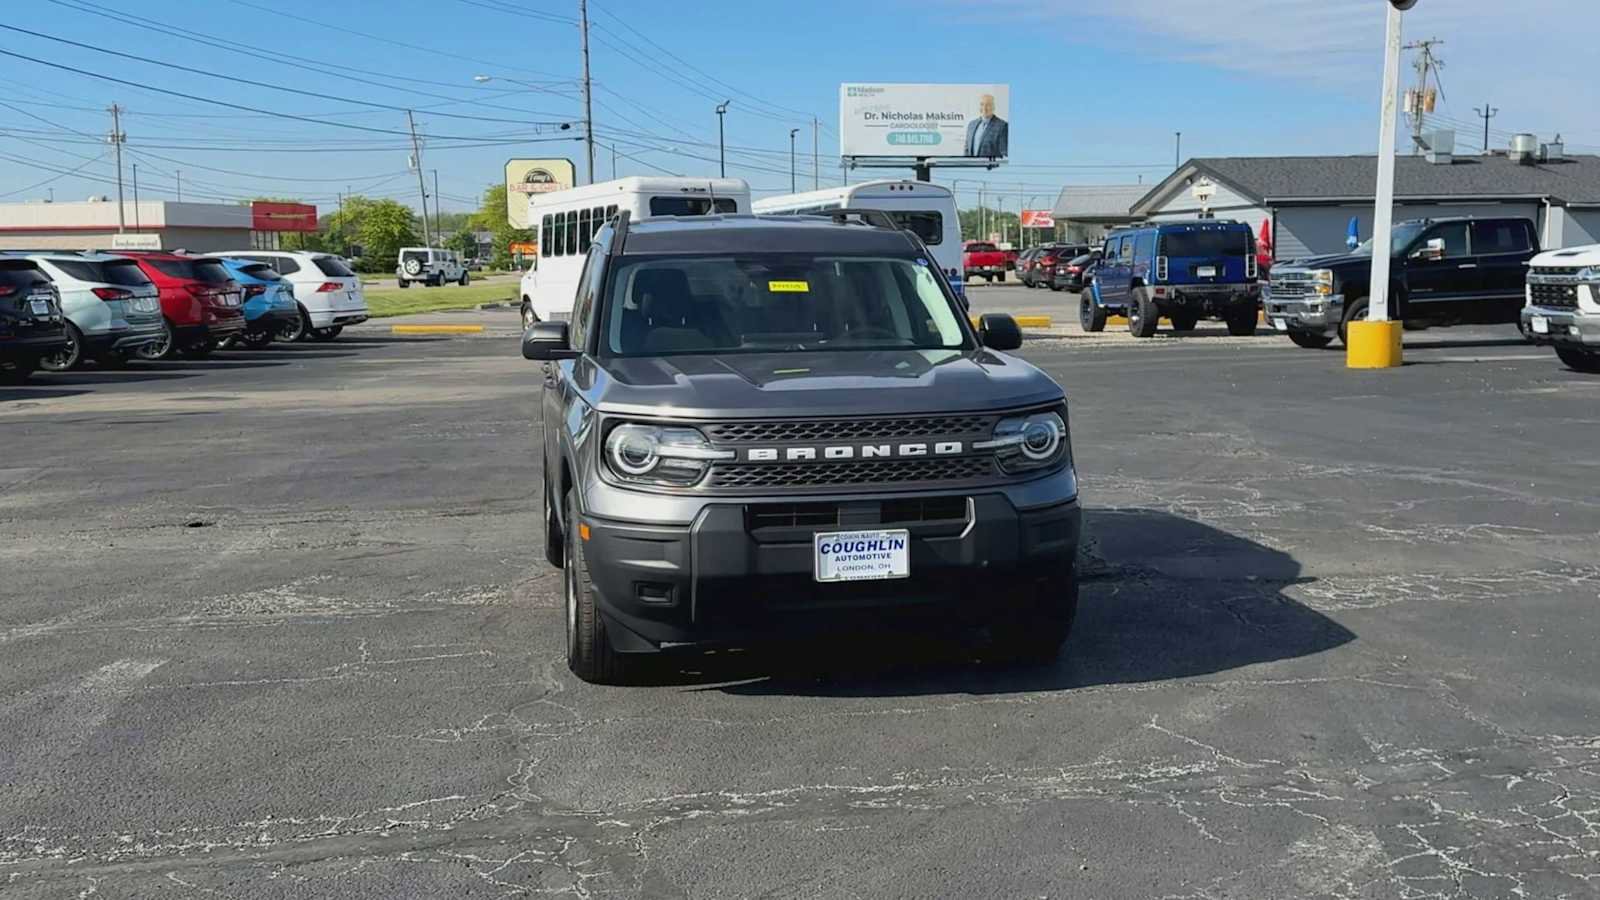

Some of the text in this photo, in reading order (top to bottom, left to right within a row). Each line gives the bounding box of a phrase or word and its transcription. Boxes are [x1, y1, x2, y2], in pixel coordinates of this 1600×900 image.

[864, 111, 965, 121] Dr. Nicholas Maksim
[748, 442, 962, 461] BRONCO
[821, 539, 905, 555] COUGHLIN
[835, 552, 892, 562] AUTOMOTIVE
